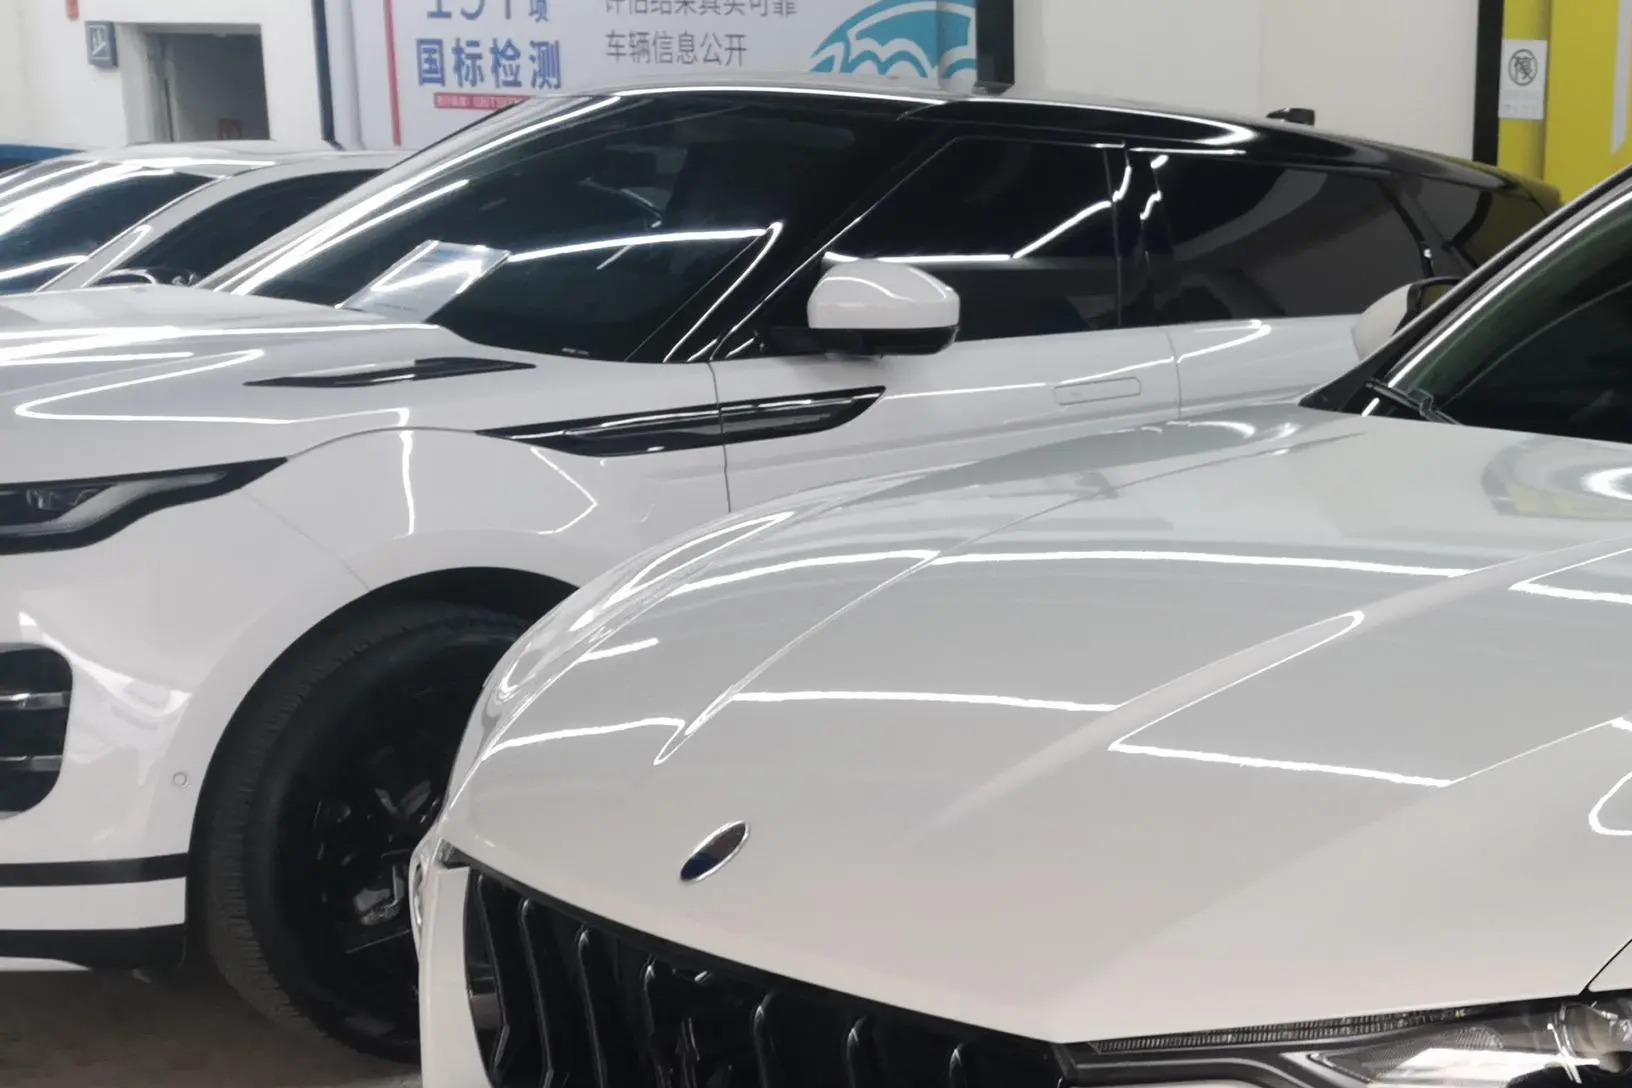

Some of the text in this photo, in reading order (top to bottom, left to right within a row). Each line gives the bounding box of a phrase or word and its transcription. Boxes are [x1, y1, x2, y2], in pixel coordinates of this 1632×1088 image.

[416, 37, 562, 90] 国标检测
[605, 29, 748, 67] 车辆信息公开
